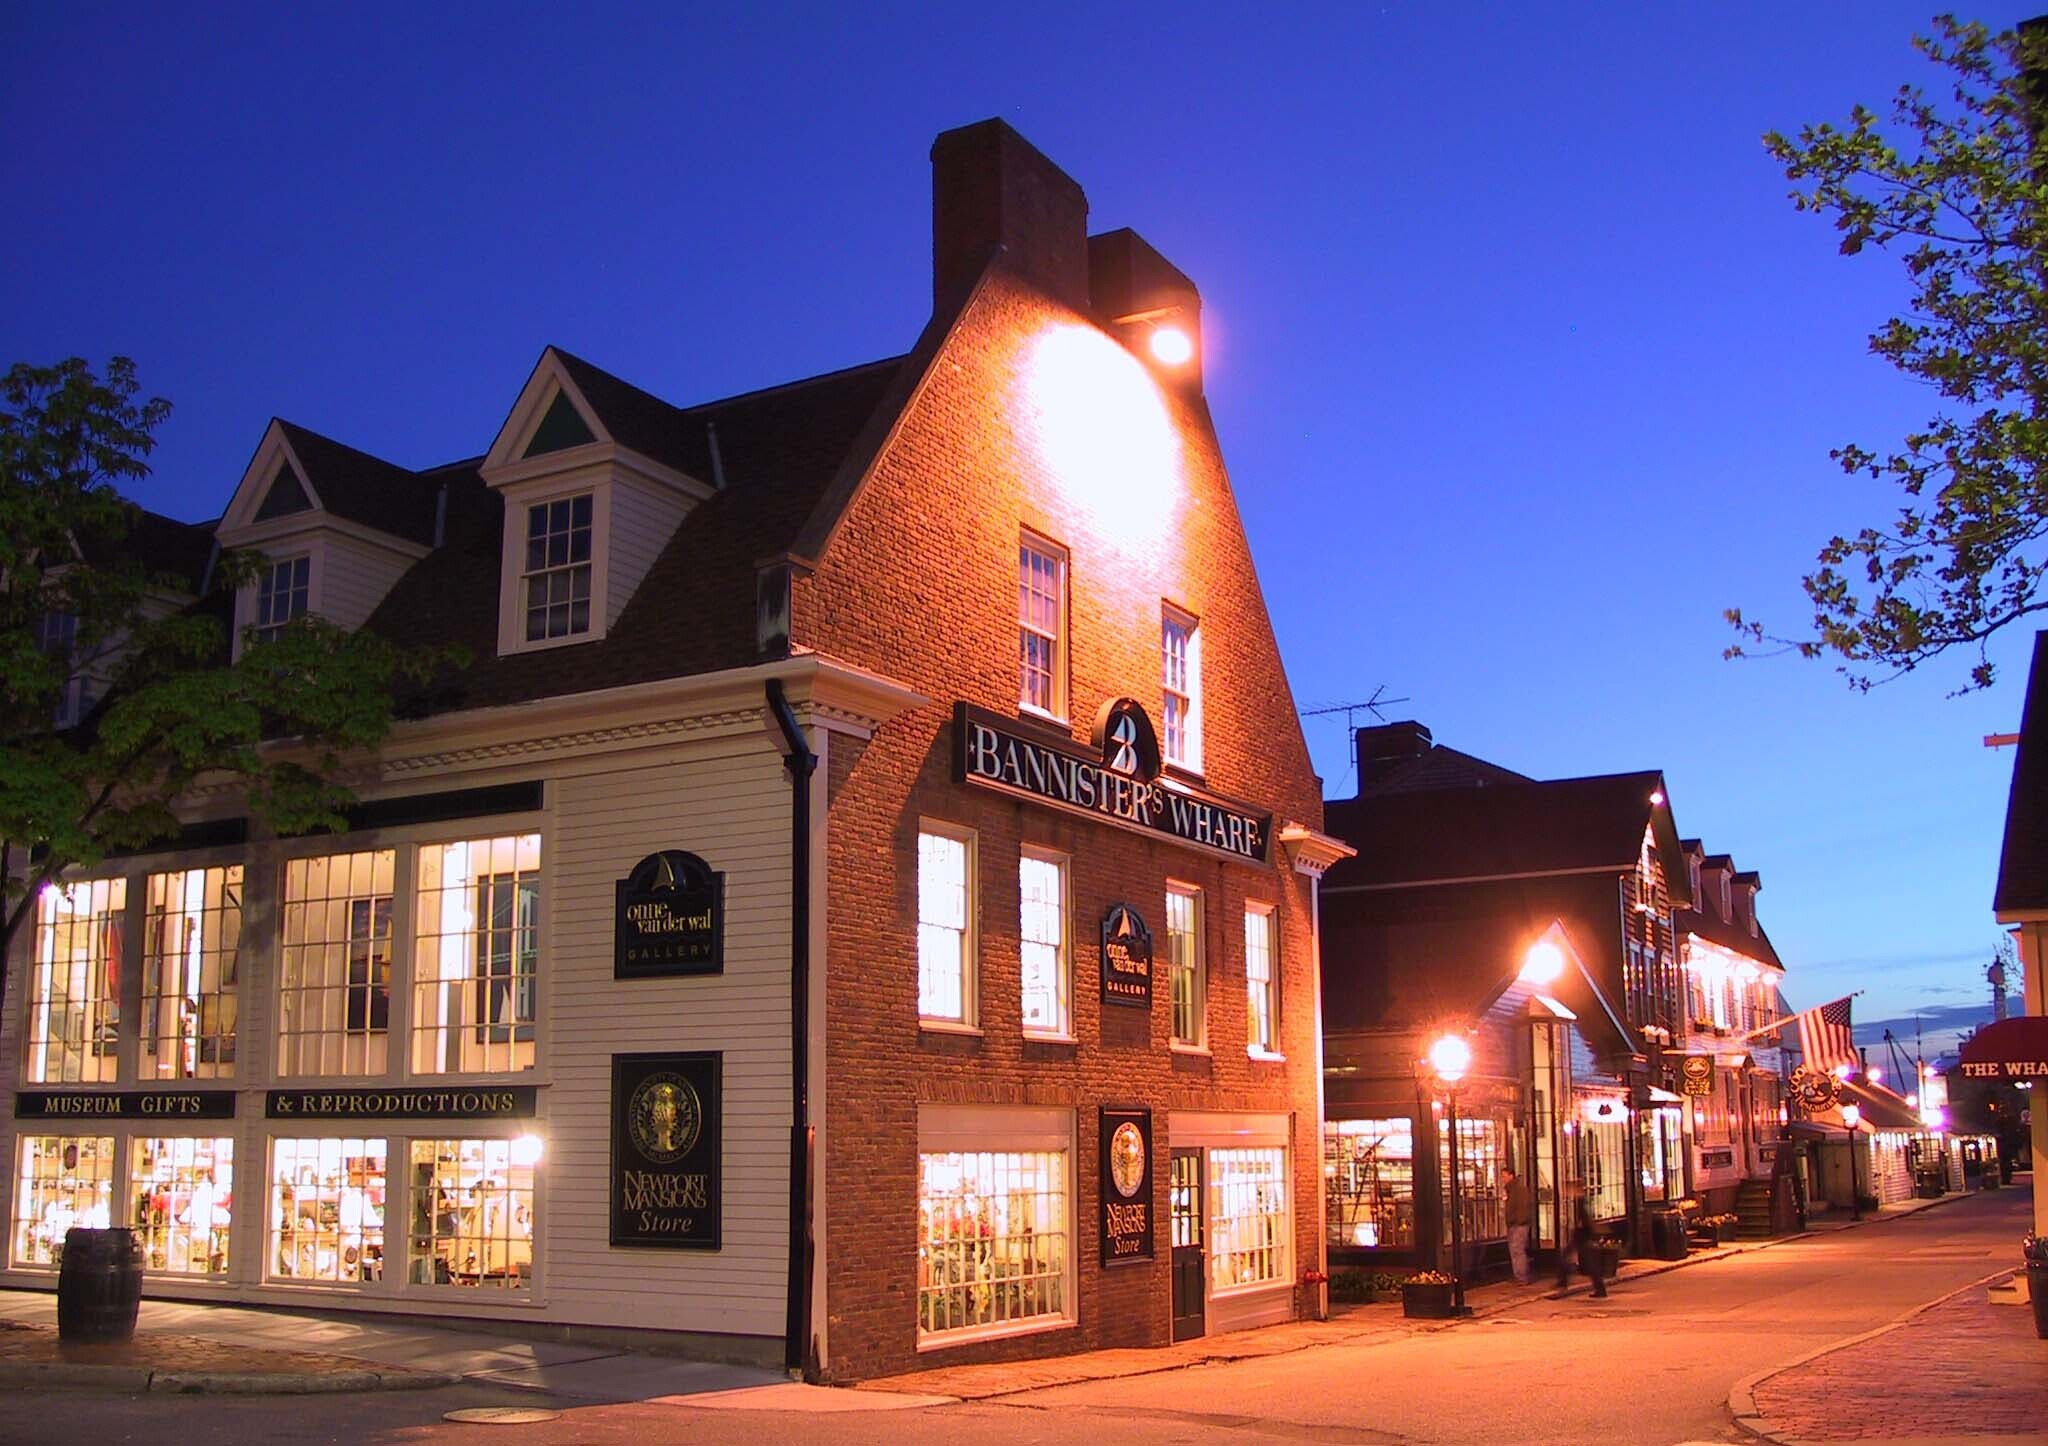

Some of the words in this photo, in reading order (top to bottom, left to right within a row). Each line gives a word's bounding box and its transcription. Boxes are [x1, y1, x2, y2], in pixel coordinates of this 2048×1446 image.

[972, 724, 1164, 825] BANNISTER'S
[1167, 793, 1260, 857] WHARF
[626, 902, 669, 921] onne
[637, 918, 661, 934] van
[662, 911, 687, 932] der
[688, 908, 713, 931] wal
[627, 944, 712, 961] GALLERY
[1107, 981, 1147, 996] GALLERY
[1961, 1062, 1999, 1077] THE
[2004, 1061, 2048, 1076] WHA
[44, 1096, 122, 1113] MUSEUM
[140, 1096, 202, 1113] GIFTS
[276, 1095, 294, 1113] &
[301, 1093, 514, 1113] REPRODUCTIONS
[623, 1169, 708, 1192] NEWPORT
[623, 1188, 708, 1211] MANSIONS
[638, 1211, 693, 1233] Store
[1106, 1202, 1147, 1222] NEWPORT
[1114, 1235, 1140, 1255] Store
